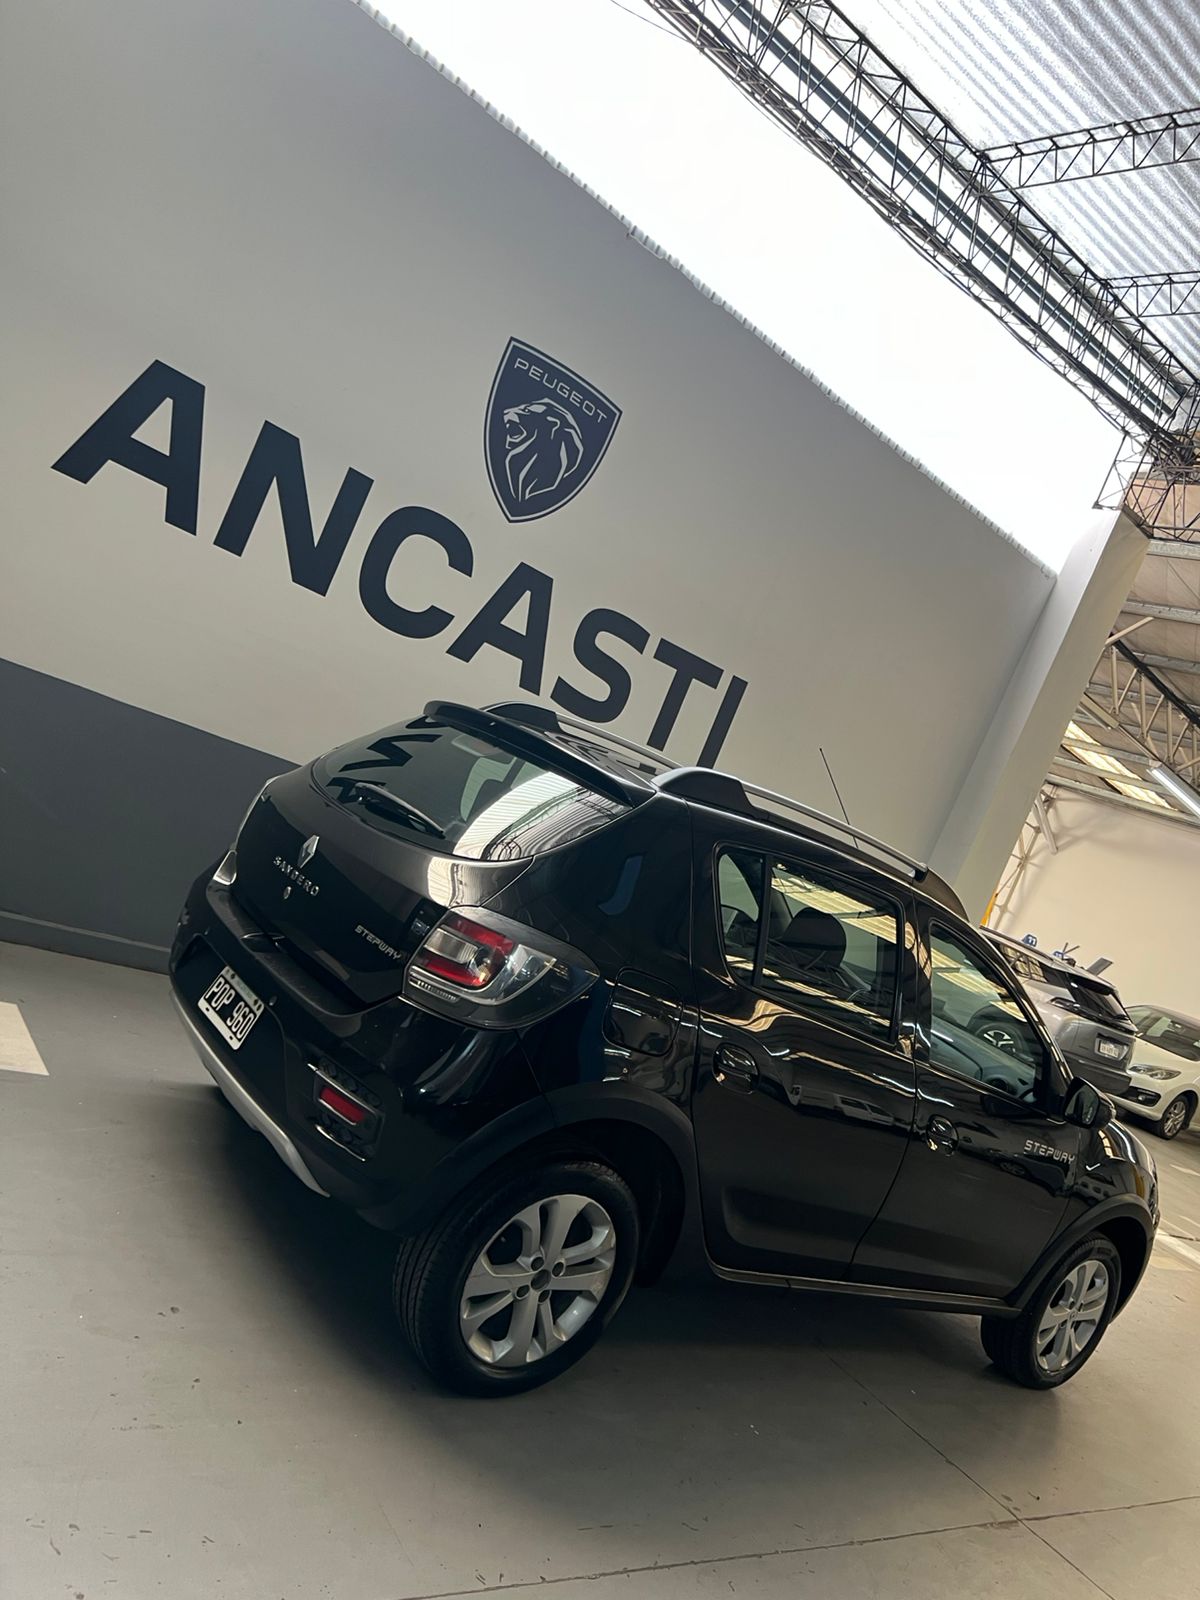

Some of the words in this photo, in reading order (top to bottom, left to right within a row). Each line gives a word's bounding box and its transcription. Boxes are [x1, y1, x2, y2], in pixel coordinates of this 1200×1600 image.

[514, 358, 607, 423] PEUGEOT
[50, 358, 748, 769] ANCASTI
[354, 924, 402, 960] STEPWAY
[204, 976, 236, 1012] POP
[226, 1001, 255, 1039] 960
[1023, 1139, 1075, 1165] STEPWAY
